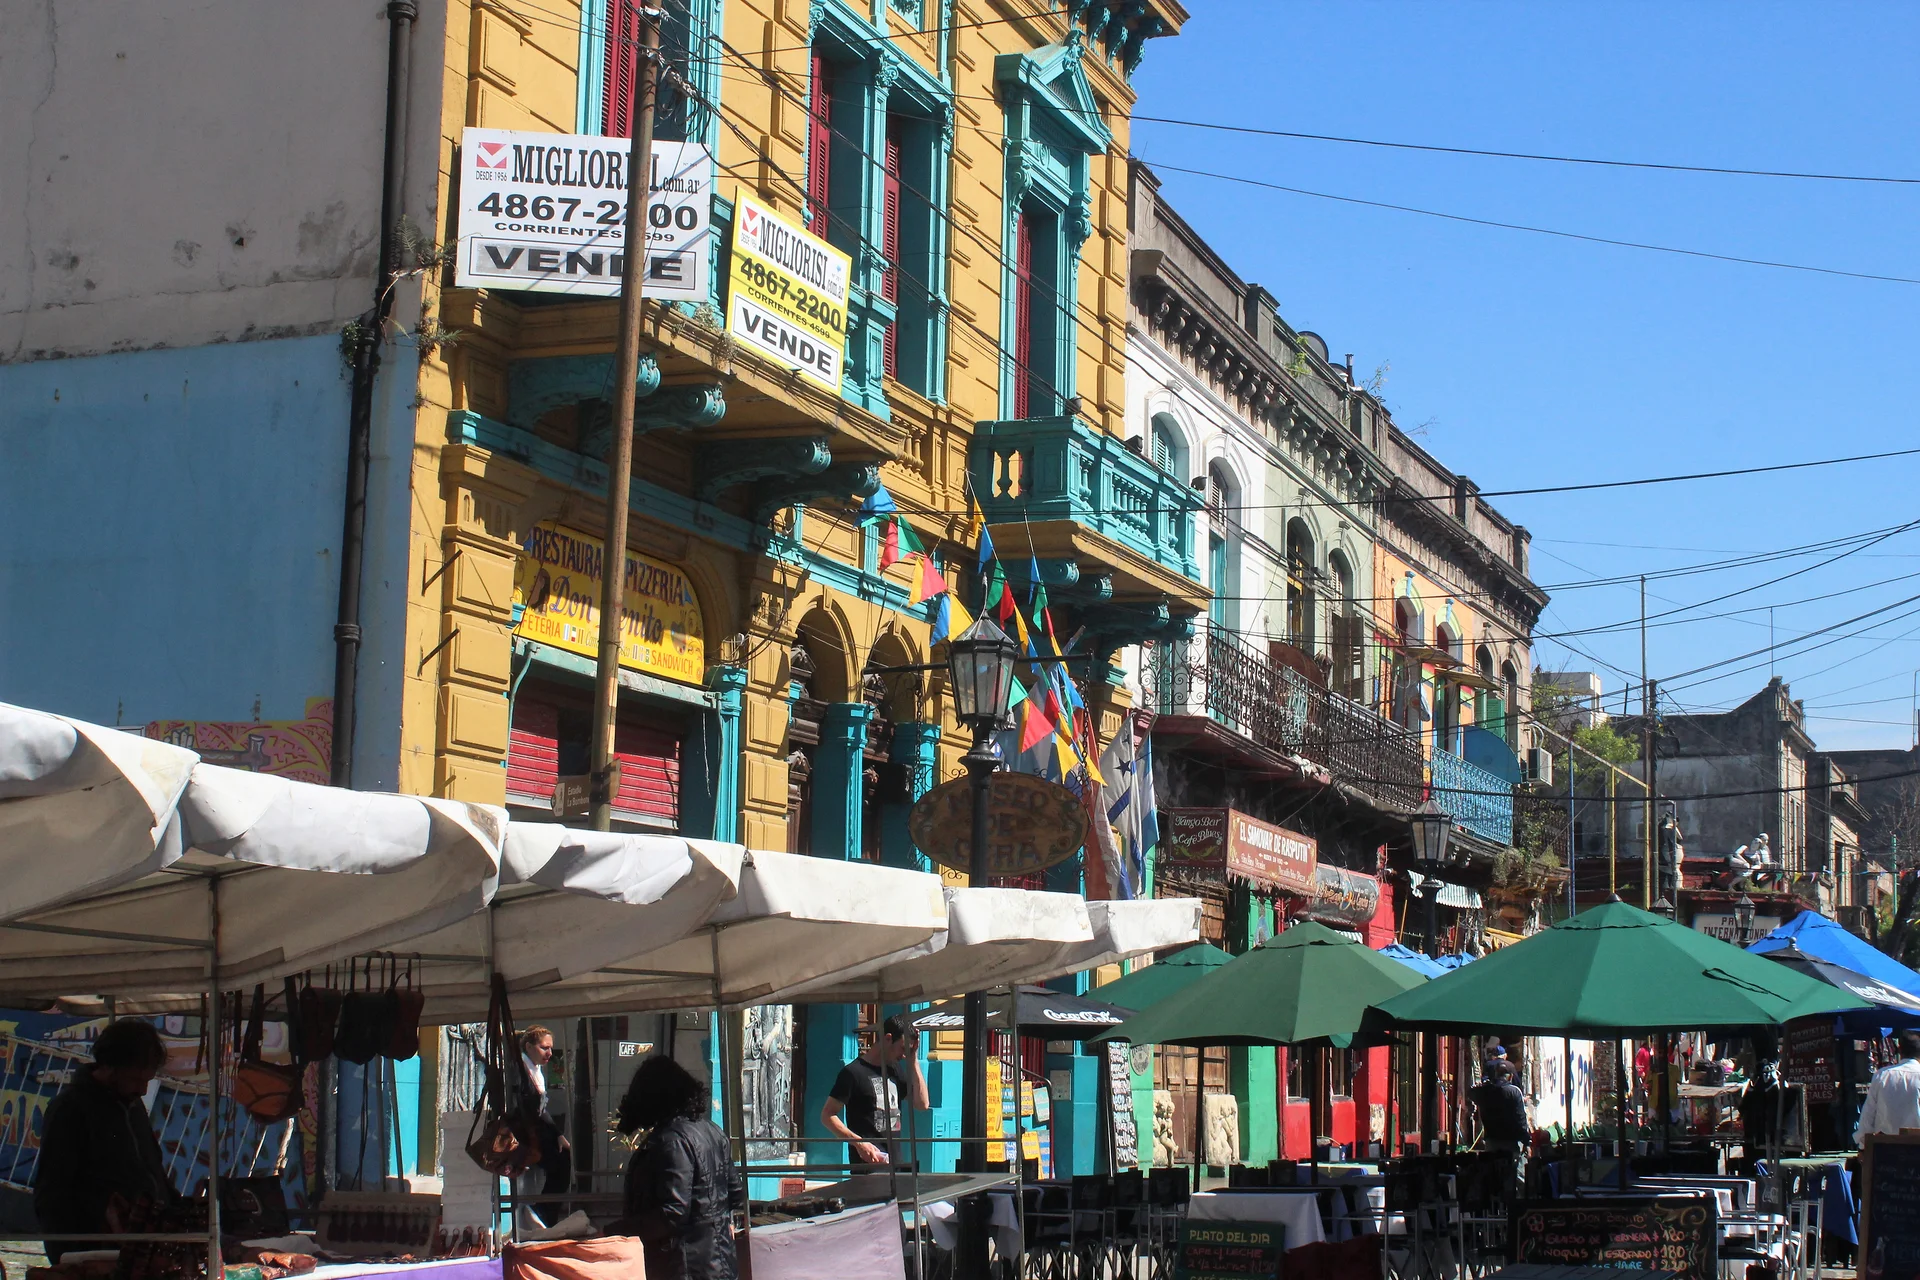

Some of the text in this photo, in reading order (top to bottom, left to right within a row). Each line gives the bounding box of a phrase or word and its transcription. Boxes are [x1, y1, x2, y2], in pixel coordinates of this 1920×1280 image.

[475, 170, 508, 182] DESDE 1956
[477, 192, 698, 231] 4867-200
[494, 222, 622, 239] CORRIENTES
[740, 257, 841, 332] 4867-2200
[747, 287, 831, 339] CORRIENTES 4599
[742, 306, 832, 376] VENDE
[531, 526, 685, 607] RESTAURA PIZZERIA
[549, 575, 665, 646] Don enito
[521, 612, 561, 638] FETERIA
[651, 649, 694, 676] SANDWICH
[1175, 815, 1222, 829] Tango Bar
[1197, 829, 1220, 842] Blues
[1247, 824, 1274, 852] SAMOVAR
[1273, 833, 1282, 854] DE
[1189, 1229, 1270, 1245] PLATO DEL DIA
